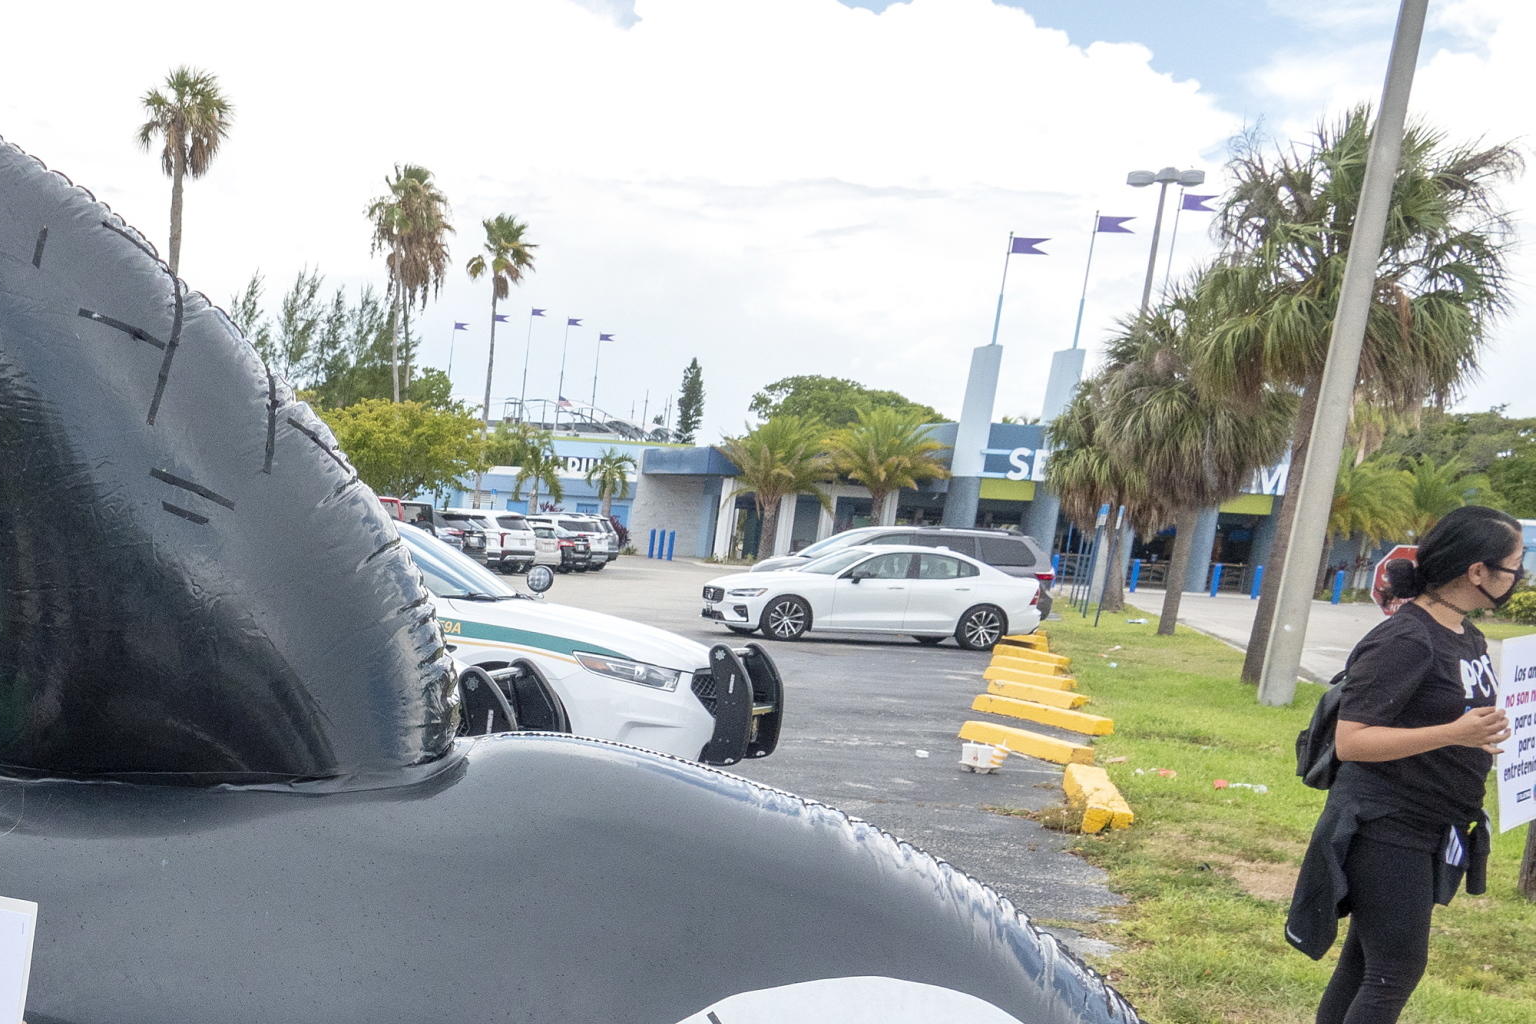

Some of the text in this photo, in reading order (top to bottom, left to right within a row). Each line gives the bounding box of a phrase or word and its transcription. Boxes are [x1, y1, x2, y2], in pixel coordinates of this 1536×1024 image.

[1514, 665, 1526, 682] Los
[1515, 714, 1532, 735] para
[1519, 736, 1535, 758] para
